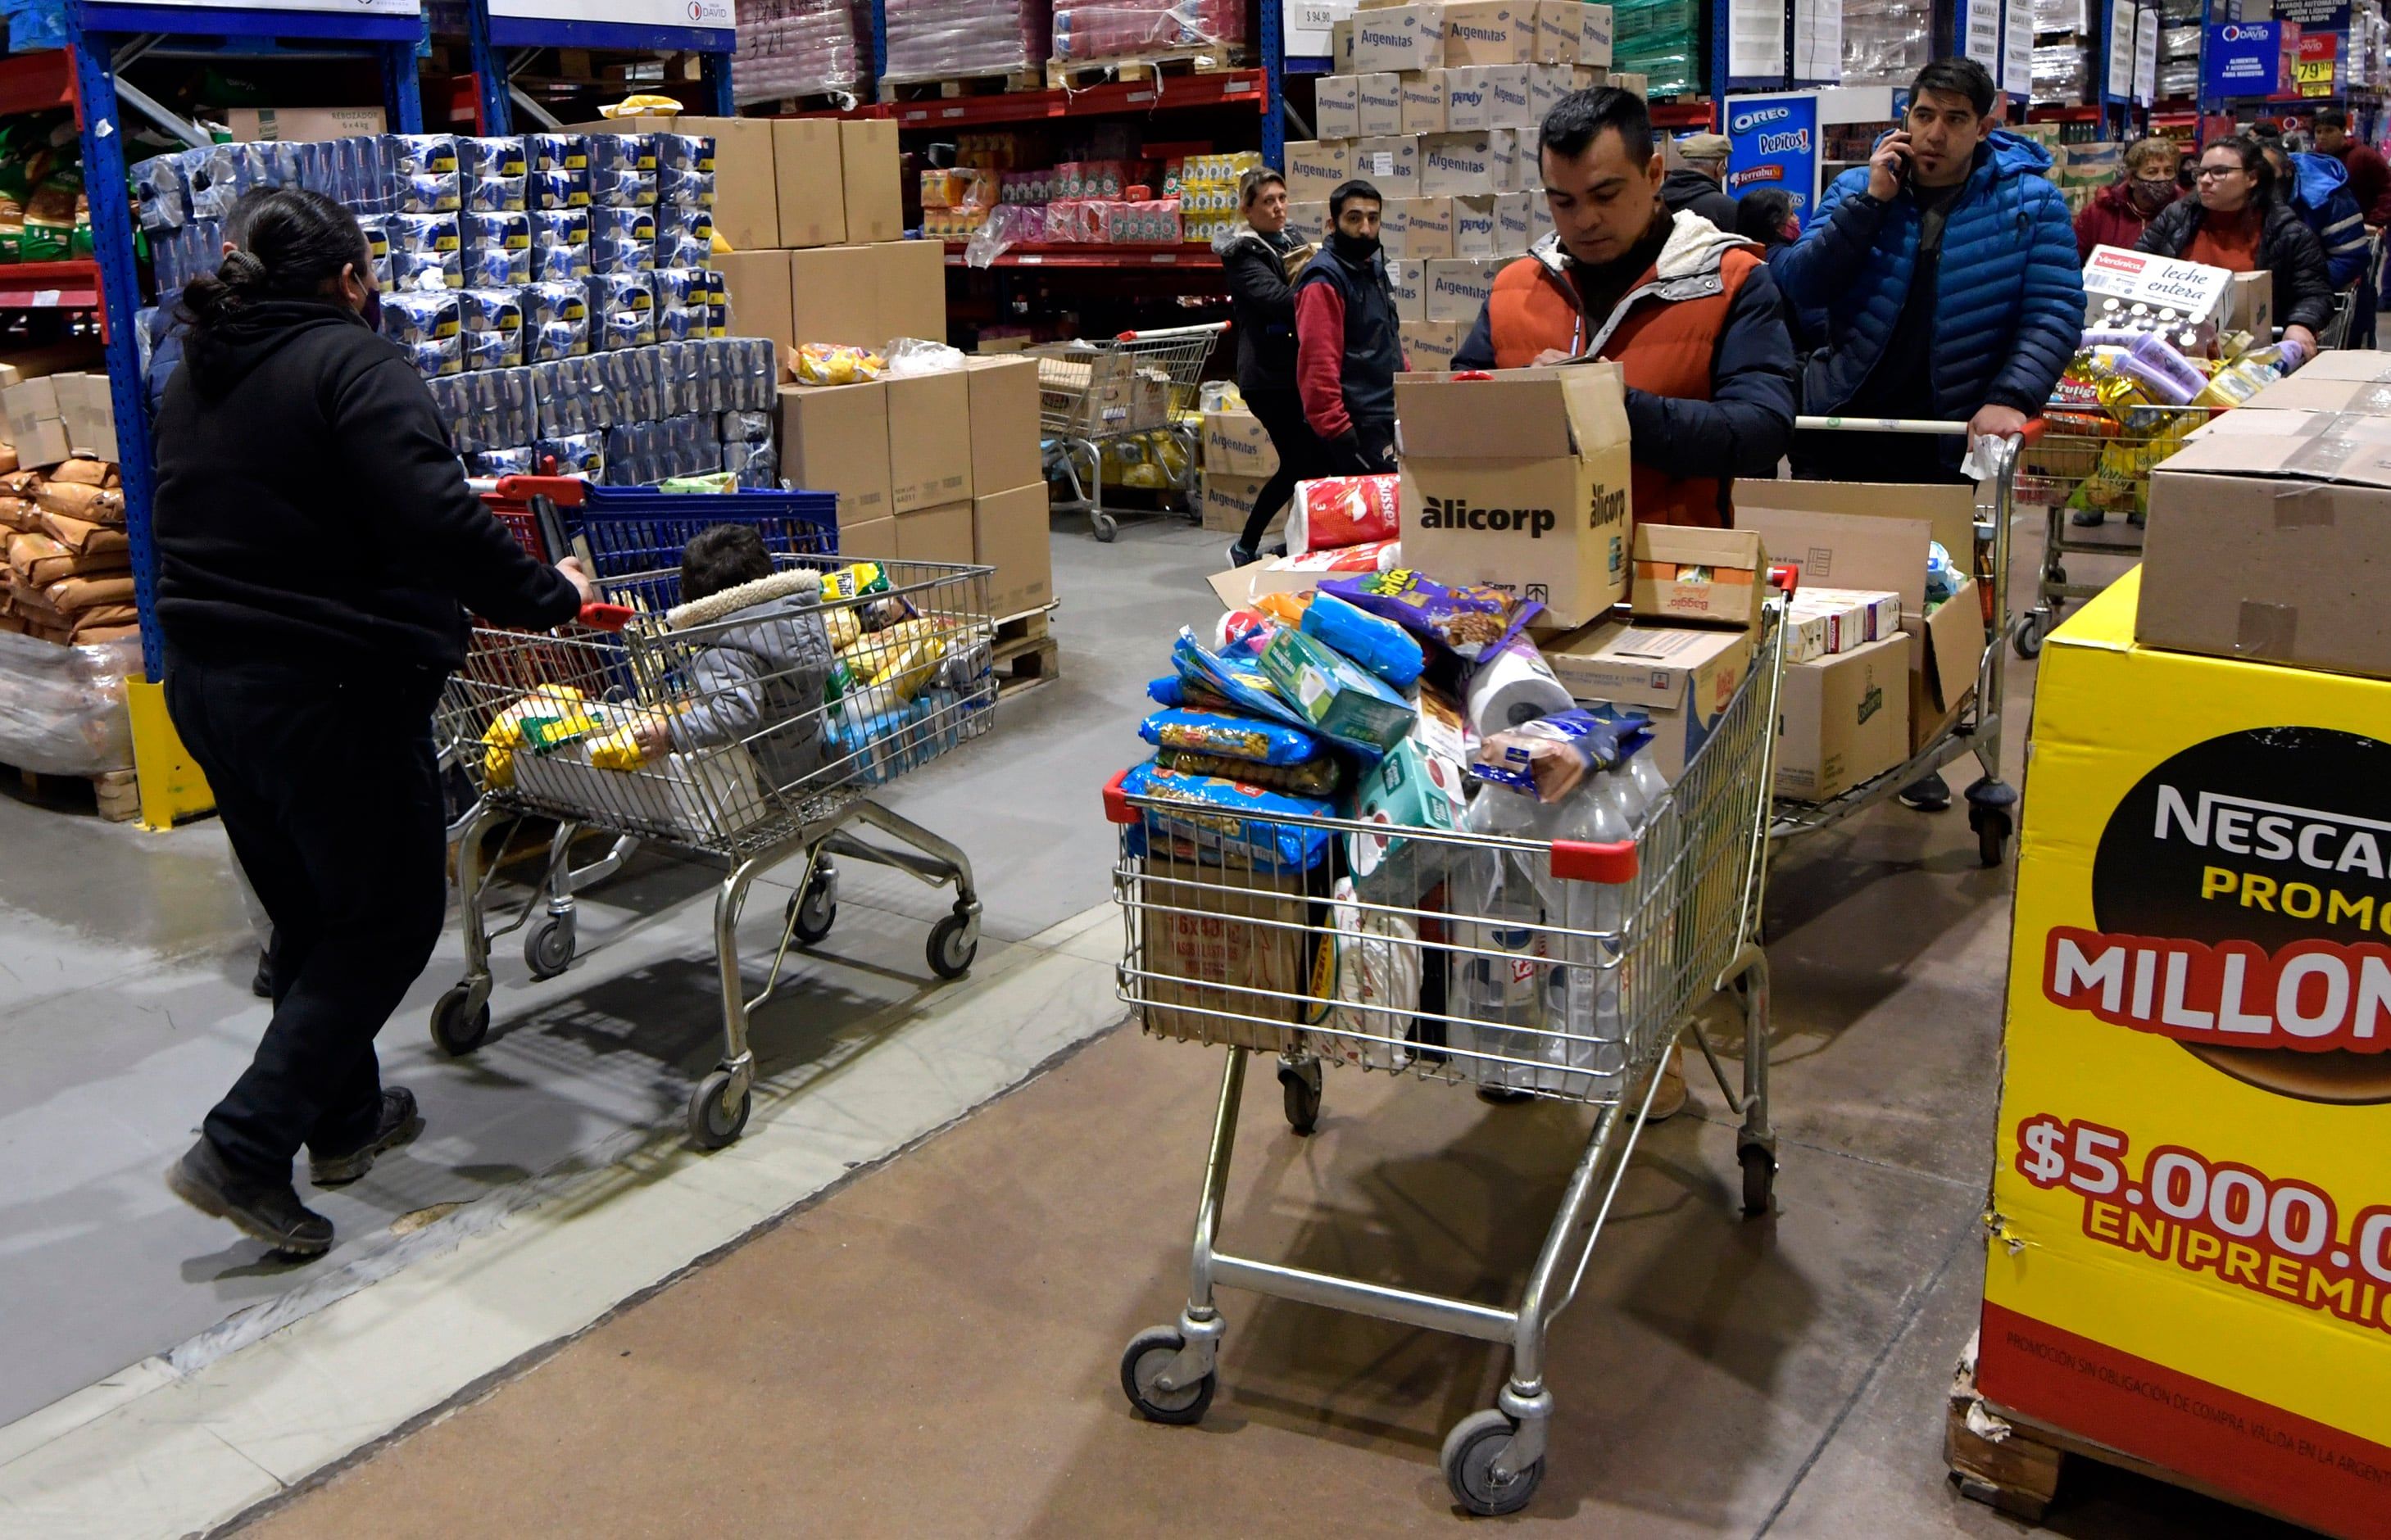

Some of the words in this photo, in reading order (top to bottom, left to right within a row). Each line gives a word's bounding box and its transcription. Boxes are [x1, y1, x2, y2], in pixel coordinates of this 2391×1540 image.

[702, 8, 727, 18] DAVID
[1360, 29, 1413, 48] Argentitas
[1450, 22, 1506, 42] Argentitas
[2239, 29, 2269, 39] DAVID
[1318, 97, 1355, 111] Argentitas
[1360, 93, 1399, 107] Argentitas
[1403, 91, 1440, 105] Argentitas
[1494, 84, 1526, 106] Argentitas
[331, 111, 379, 120] REBOZADOR
[1733, 107, 1790, 130] OREO
[1291, 161, 1343, 179] Argentitas
[1427, 152, 1485, 174] Argentitas
[1295, 224, 1323, 235] gentitas
[1380, 222, 1406, 233] entitas
[1409, 216, 1449, 232] Argentitas
[1500, 213, 1527, 233] Argentitas
[2098, 254, 2144, 271] Verónica
[2162, 265, 2209, 285] leche
[1435, 278, 1492, 300] Argentitas
[2147, 280, 2207, 301] entera
[1414, 339, 1454, 356] Argentitas
[1210, 431, 1258, 455] Argentitas
[1377, 476, 1397, 528] Sussex
[1671, 597, 1708, 611] Baggio
[2154, 783, 2391, 880] NESCA
[2201, 865, 2391, 936] PROM
[2090, 1198, 2166, 1261] EN
[2185, 1229, 2391, 1327] PREMI
[2078, 1357, 2096, 1377] SIN
[2174, 1393, 2189, 1413] DE
[2298, 1439, 2316, 1459] EN
[2318, 1450, 2334, 1465] LA
